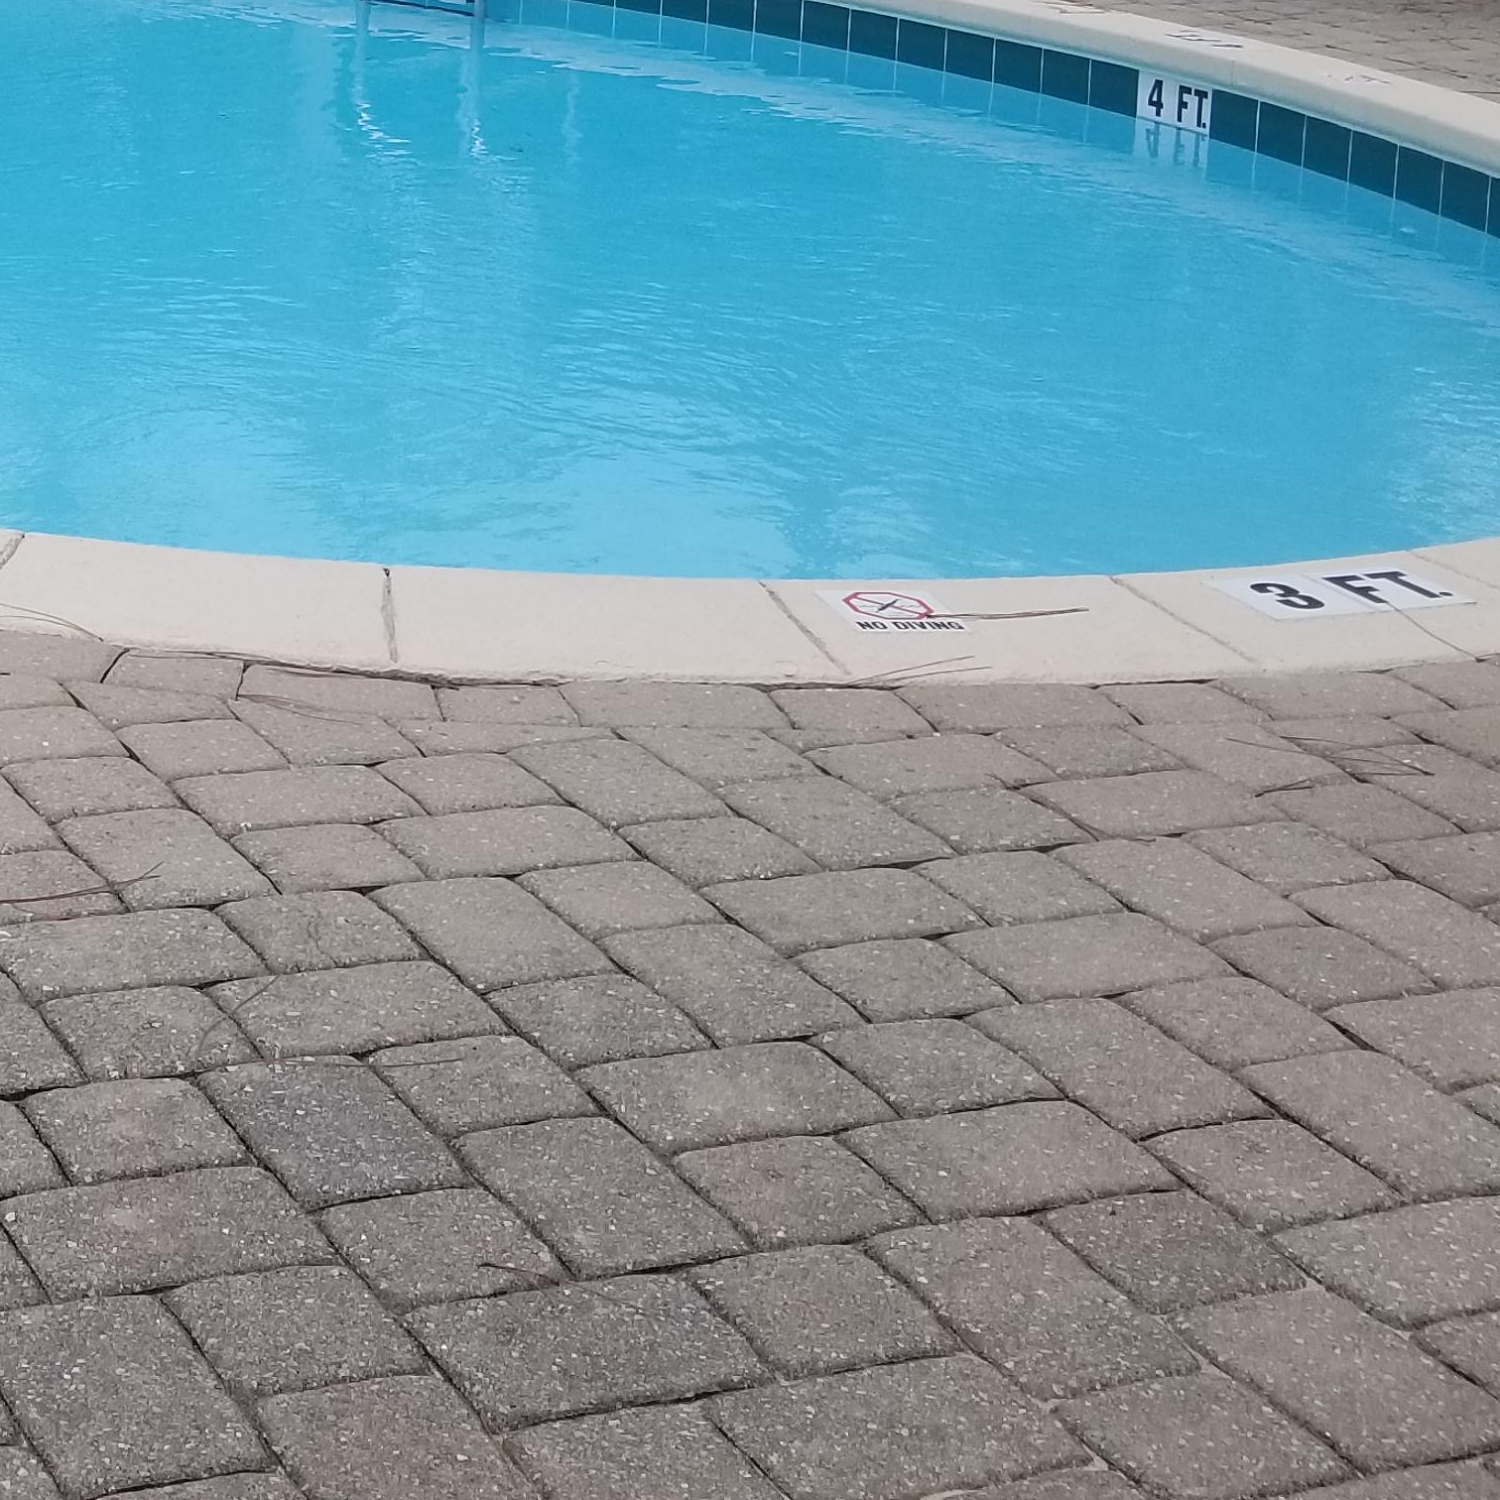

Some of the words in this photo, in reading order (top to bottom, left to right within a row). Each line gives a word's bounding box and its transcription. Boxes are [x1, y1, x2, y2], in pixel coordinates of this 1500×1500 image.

[1148, 79, 1164, 117] 4
[1176, 84, 1208, 129] FT.
[1250, 582, 1325, 609] 3
[1321, 571, 1453, 604] FT.
[855, 621, 888, 630] NO
[891, 621, 965, 630] DIVING
